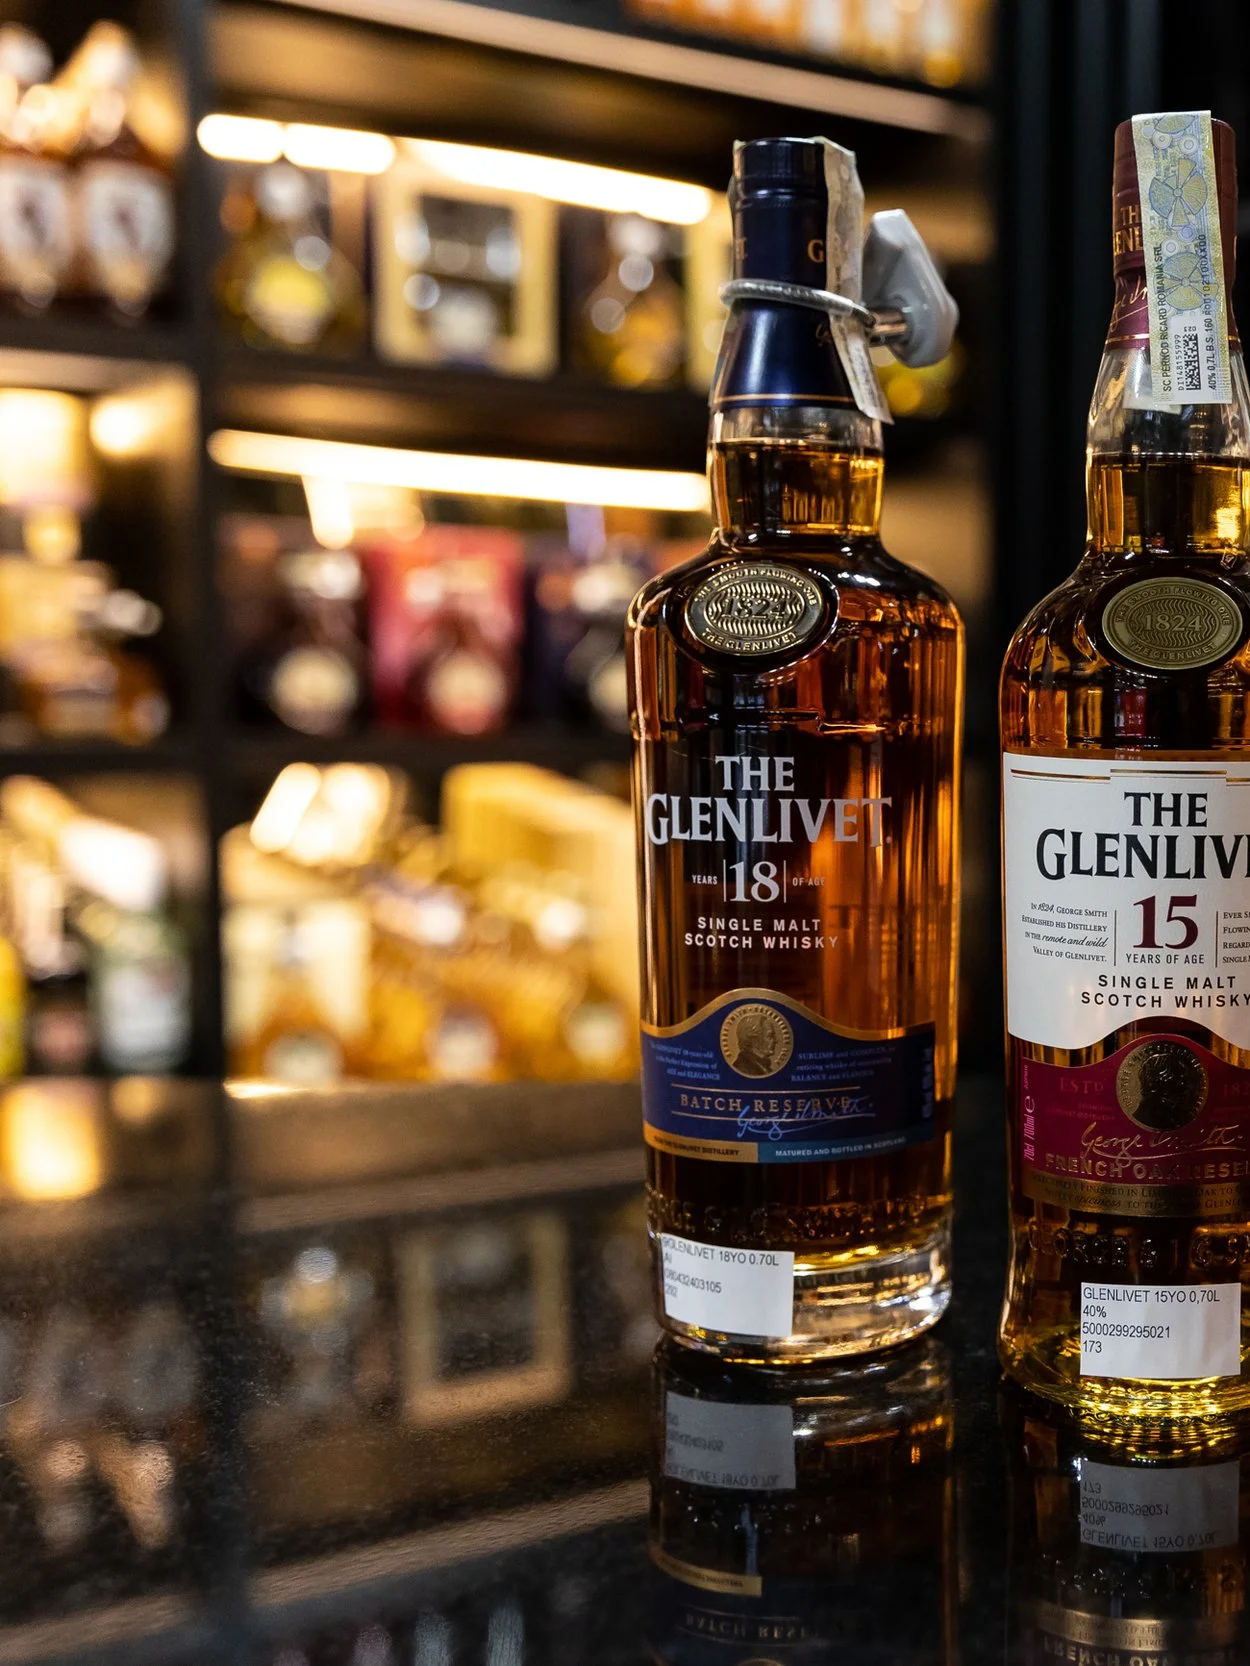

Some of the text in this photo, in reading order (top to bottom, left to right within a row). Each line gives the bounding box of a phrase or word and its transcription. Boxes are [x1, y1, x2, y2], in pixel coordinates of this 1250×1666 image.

[1120, 207, 1139, 225] TH
[1154, 243, 1172, 392] SC PERNOD RICARD ROMANIA SRL
[1204, 318, 1214, 332] 160
[1207, 373, 1217, 390] 40%
[721, 598, 788, 620] 1824
[1128, 587, 1170, 608] SMOOTH
[1174, 587, 1217, 606] FLOWING
[1217, 606, 1232, 626] ONE
[1144, 614, 1202, 632] 1824
[702, 628, 797, 651] THE GLENLIVET
[1129, 639, 1217, 660] THE GLENLIVET
[715, 755, 795, 792] THE
[1123, 791, 1208, 827] THE
[646, 793, 892, 848] GLENLIVET
[692, 875, 718, 886] YEARS
[729, 861, 780, 903] 18
[792, 877, 805, 887] OF
[1056, 906, 1083, 915] GEORGE
[1084, 908, 1108, 918] SMITH
[1223, 911, 1243, 919] EVER
[698, 917, 822, 932] SINGLE MALT
[1021, 915, 1108, 932] ESTABLISHED HIS DISTILLERY
[1133, 894, 1199, 950] 15
[685, 934, 839, 949] SCOTCH WHISKY
[1042, 935, 1066, 944] remote
[1067, 936, 1088, 946] and
[1086, 937, 1109, 948] wild
[1033, 945, 1054, 957] VALLEY
[1126, 953, 1205, 965] YEARS OF AGE
[1222, 955, 1248, 963] SINGLE
[1098, 975, 1236, 989] SINGLE MALT
[1081, 992, 1162, 1008] SCOTCH
[680, 1094, 851, 1113] BATCH RESERVE
[831, 1145, 863, 1154] BOTTLED
[1045, 1152, 1124, 1179] FRENCH
[1135, 1162, 1180, 1182] OAK
[1080, 1182, 1124, 1195] FINISHED
[1127, 1187, 1138, 1195] IN
[1127, 1200, 1140, 1208] TO
[719, 1251, 779, 1266] 18YO 0.70L
[1083, 1287, 1220, 1305] GLENLIVET 15YO 0,70L
[1083, 1305, 1107, 1318] 40%
[1082, 1322, 1170, 1338] 5000299295021
[1082, 1340, 1102, 1353] 173
